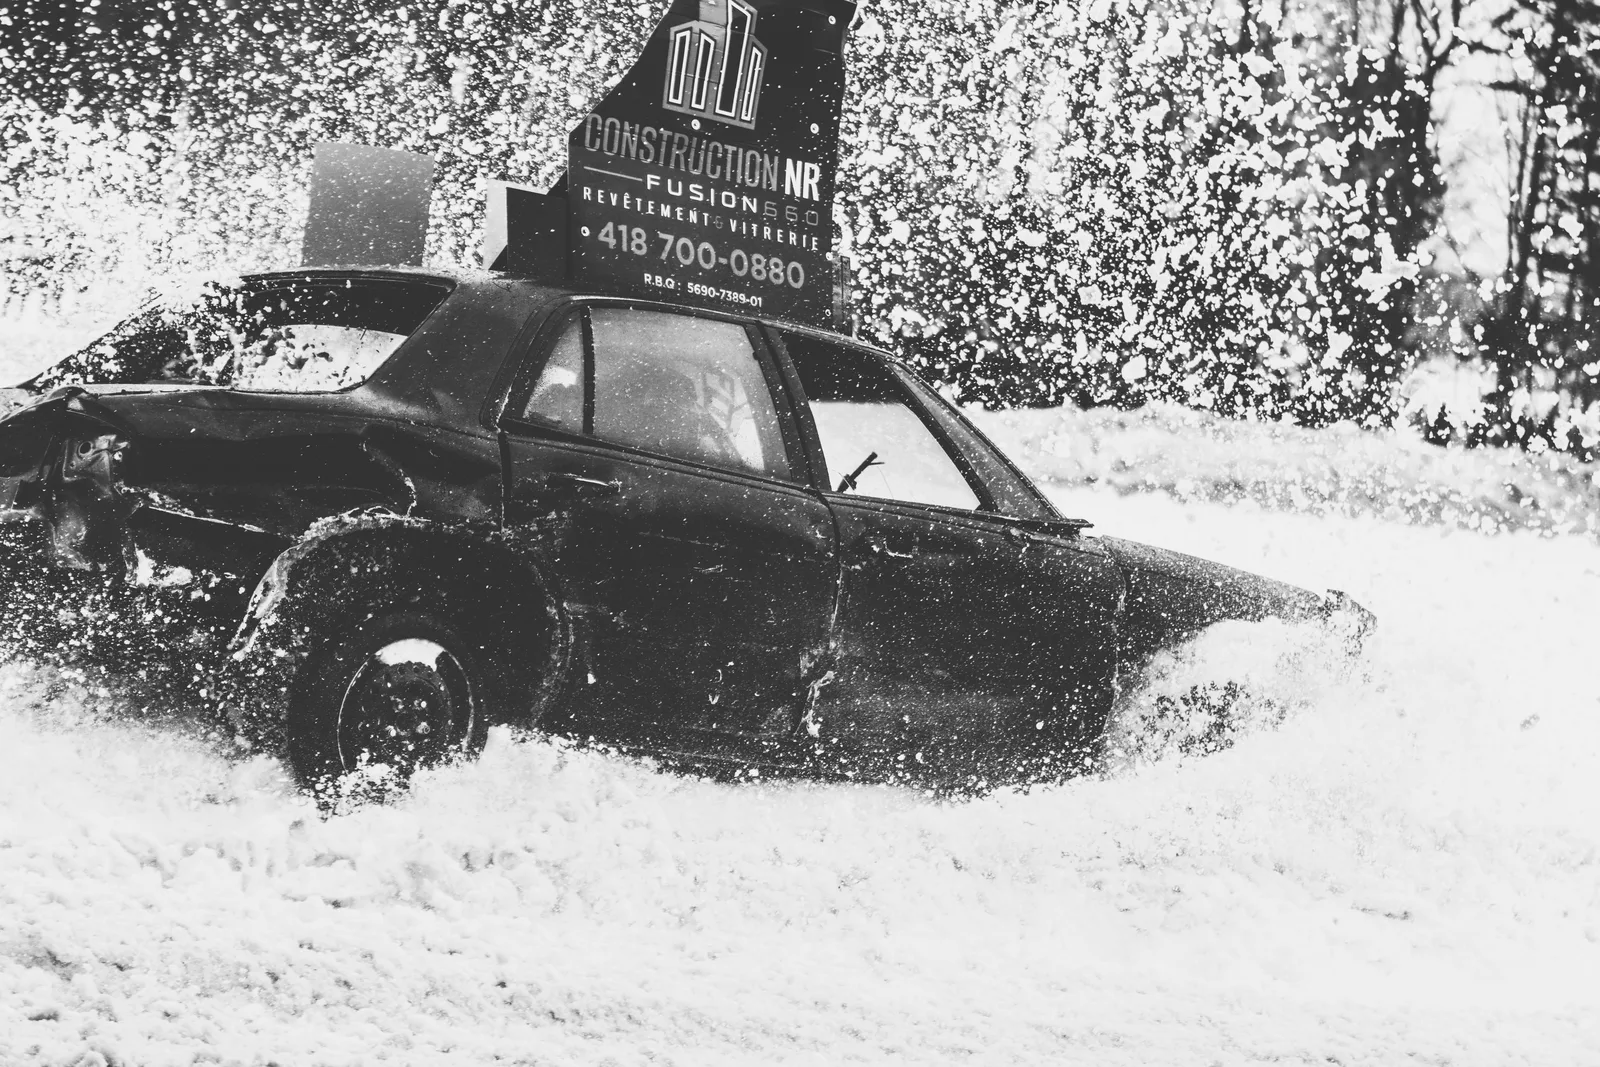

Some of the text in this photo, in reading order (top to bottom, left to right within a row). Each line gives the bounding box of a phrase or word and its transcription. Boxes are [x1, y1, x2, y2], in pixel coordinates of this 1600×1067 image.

[584, 113, 820, 201] CONSTRUCTION NR
[598, 221, 805, 289] 418 700-0880
[729, 218, 819, 251] VITRERIE
[687, 282, 763, 308] 5690-7389-01
